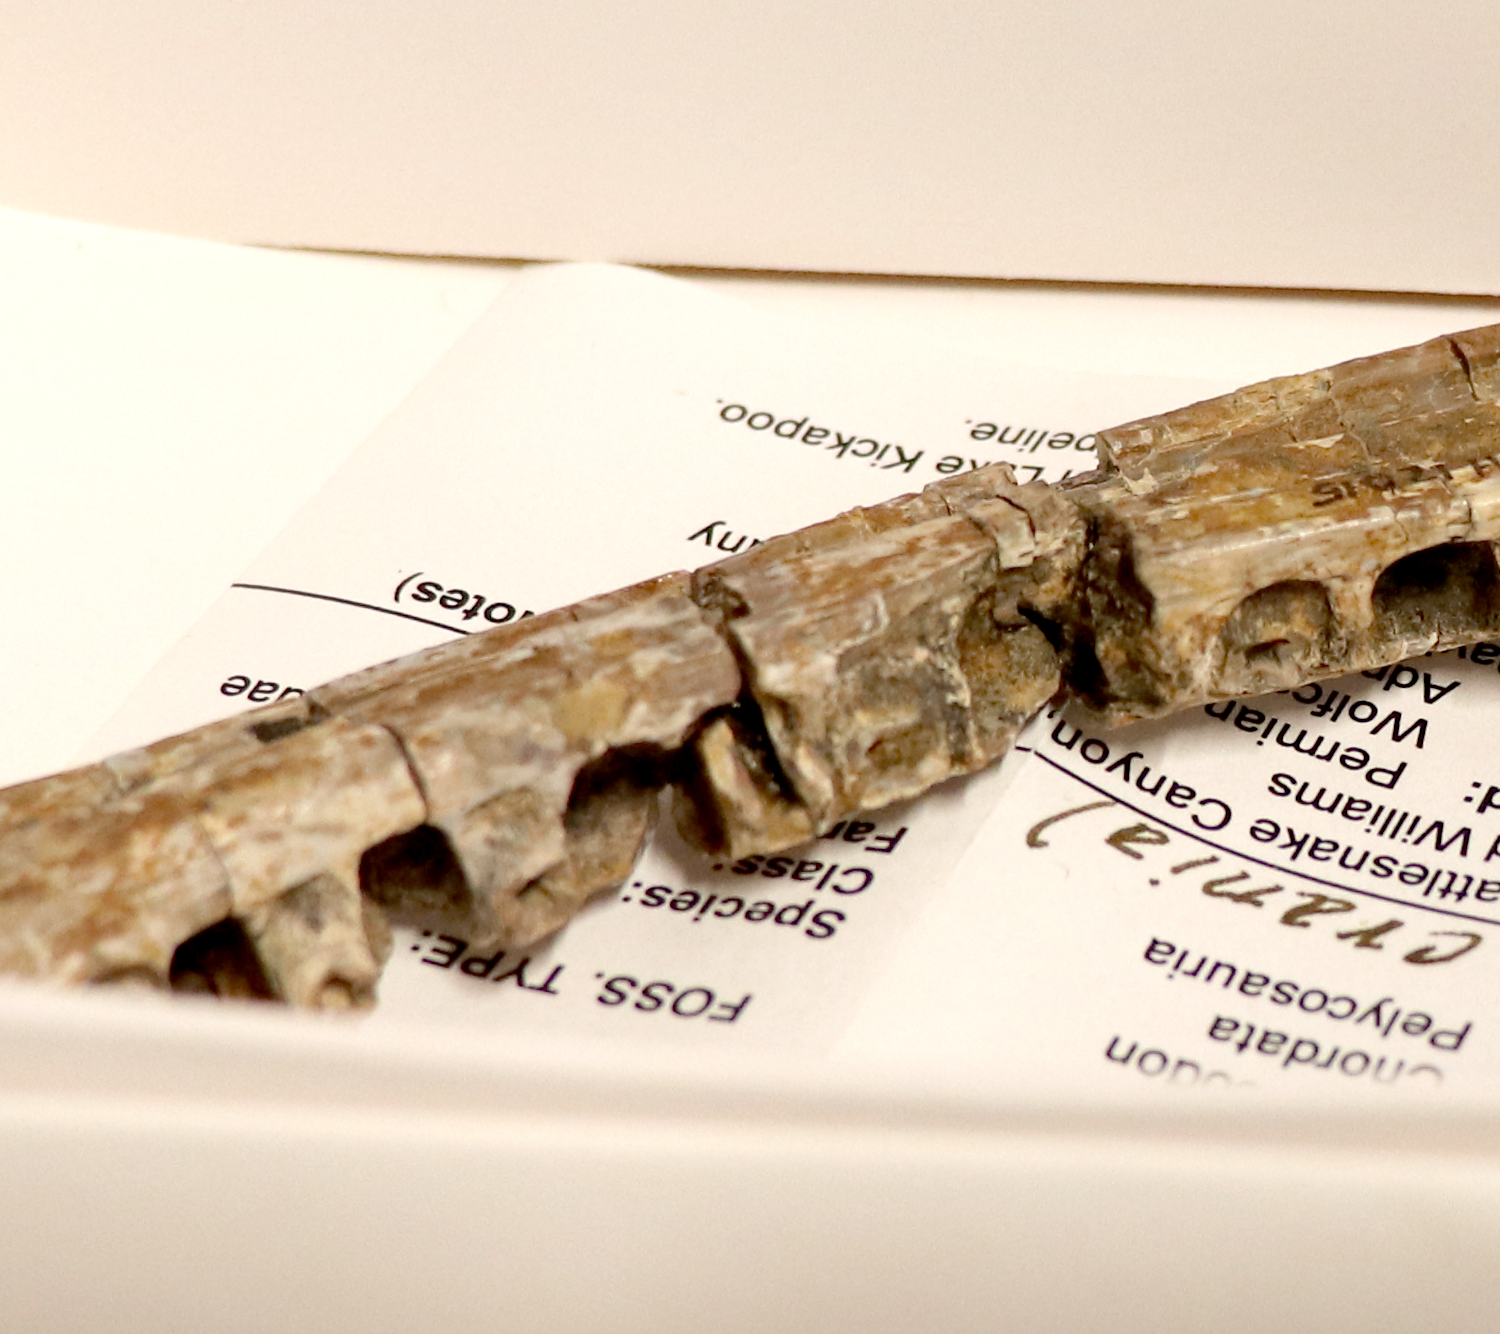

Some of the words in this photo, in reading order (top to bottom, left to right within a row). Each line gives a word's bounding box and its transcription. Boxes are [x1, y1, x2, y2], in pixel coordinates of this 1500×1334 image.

[715, 397, 925, 475] Kickapoo.
[687, 520, 763, 554] ny
[392, 570, 536, 623] otes)
[1203, 700, 1409, 791] Permian
[1284, 680, 1430, 750] Wolfc
[1045, 707, 1233, 834] Canyon,
[1266, 770, 1476, 859] Williams
[621, 878, 848, 940] Species:
[712, 853, 876, 897] Class:
[410, 929, 568, 996] TYPE:
[1142, 935, 1473, 1054] Pelycosauria
[593, 969, 753, 1025] FOSS.
